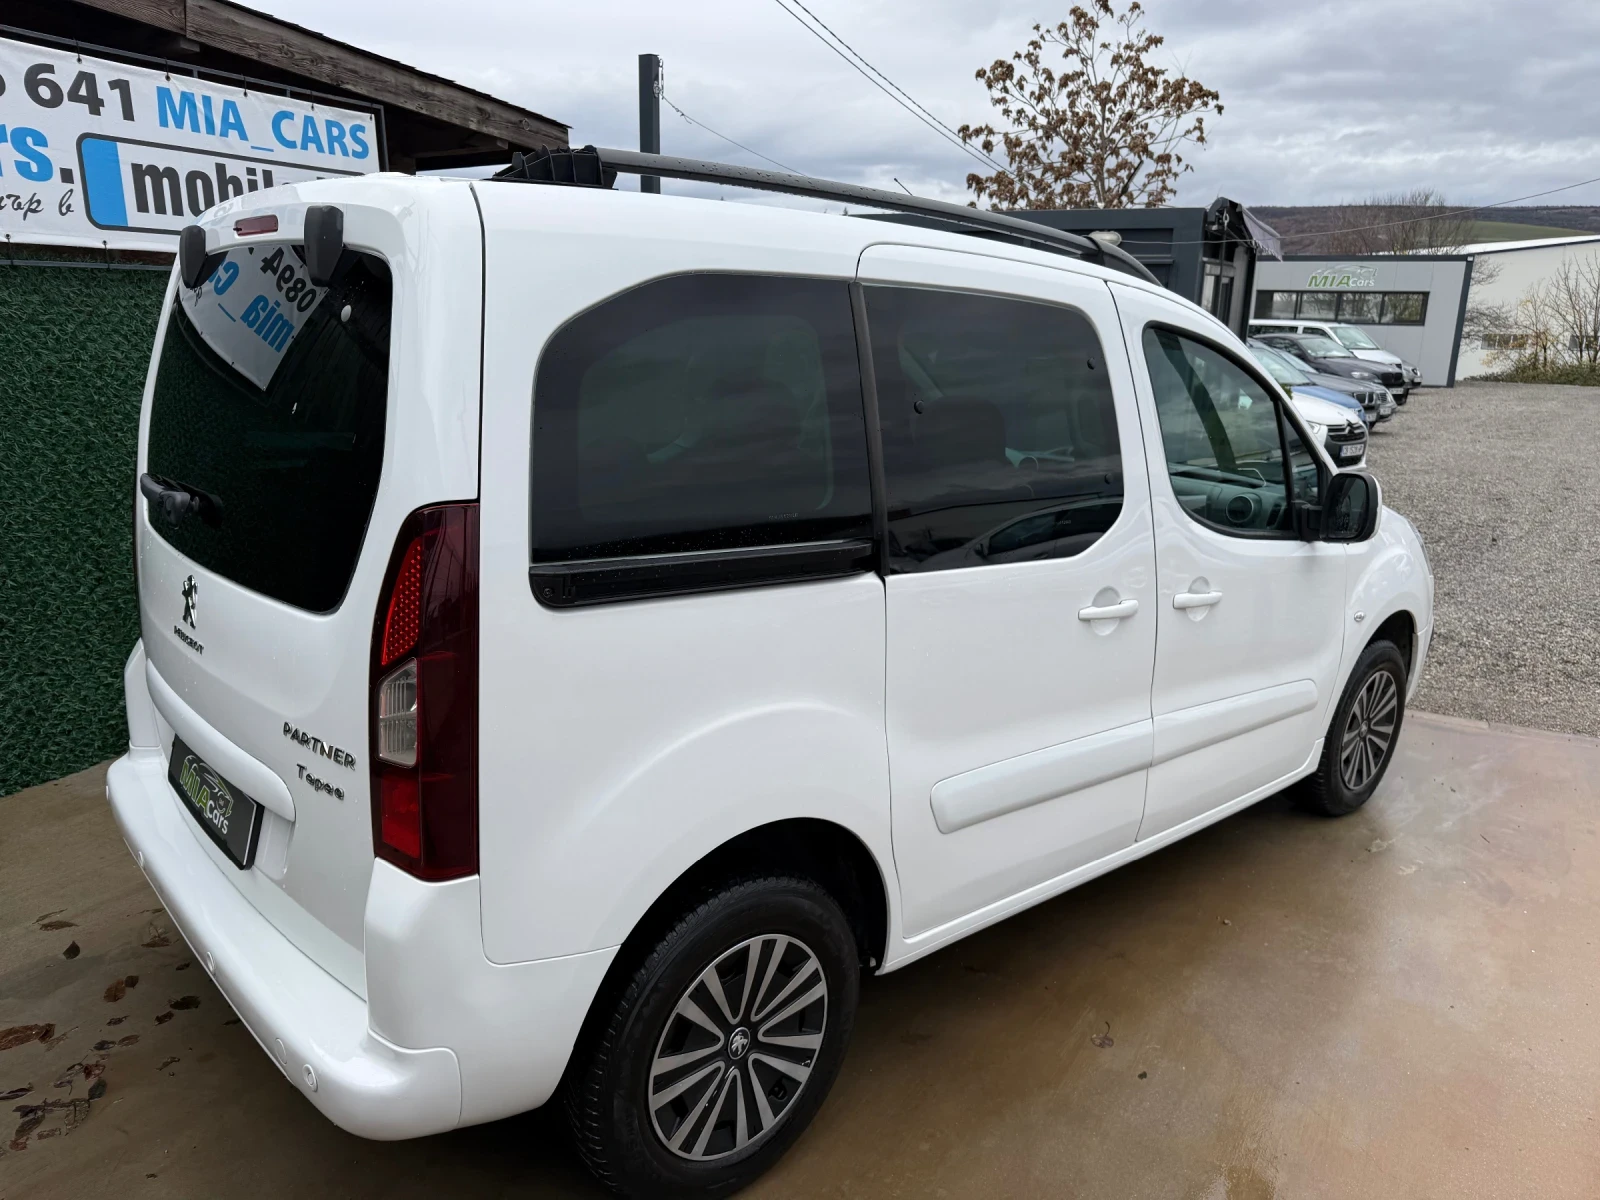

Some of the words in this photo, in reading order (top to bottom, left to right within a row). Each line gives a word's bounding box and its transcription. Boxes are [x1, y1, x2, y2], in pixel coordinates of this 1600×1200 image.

[24, 63, 136, 122] 641
[156, 85, 370, 160] MIA_CARS
[1306, 274, 1351, 288] MIA
[283, 721, 356, 771] PARTNER
[296, 763, 345, 801] Tepee
